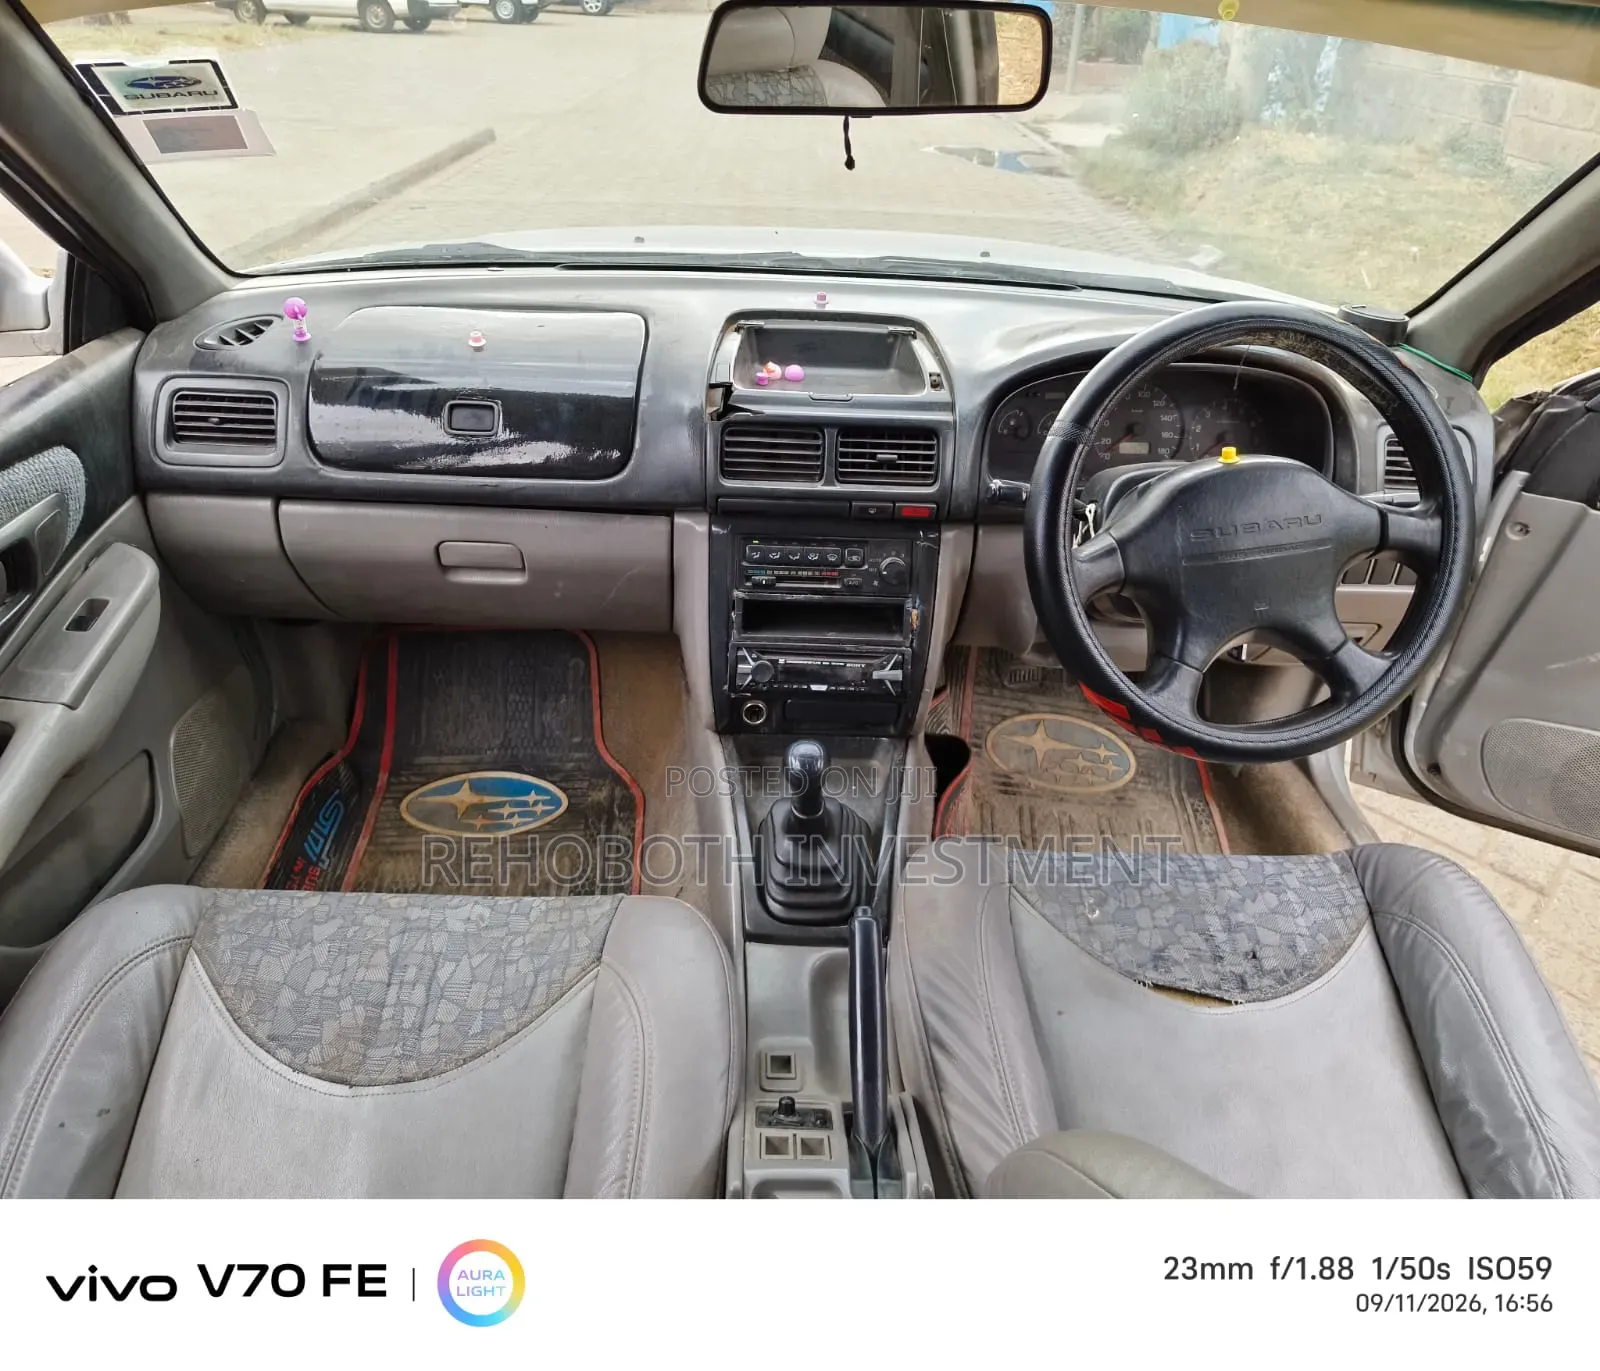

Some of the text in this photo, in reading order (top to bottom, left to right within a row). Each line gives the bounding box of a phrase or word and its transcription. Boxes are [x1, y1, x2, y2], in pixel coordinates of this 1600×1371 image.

[123, 90, 218, 101] SUBARU
[1152, 400, 1166, 408] 120
[1160, 414, 1173, 422] 140
[1161, 431, 1174, 439] 160
[1190, 513, 1322, 541] SUBARU
